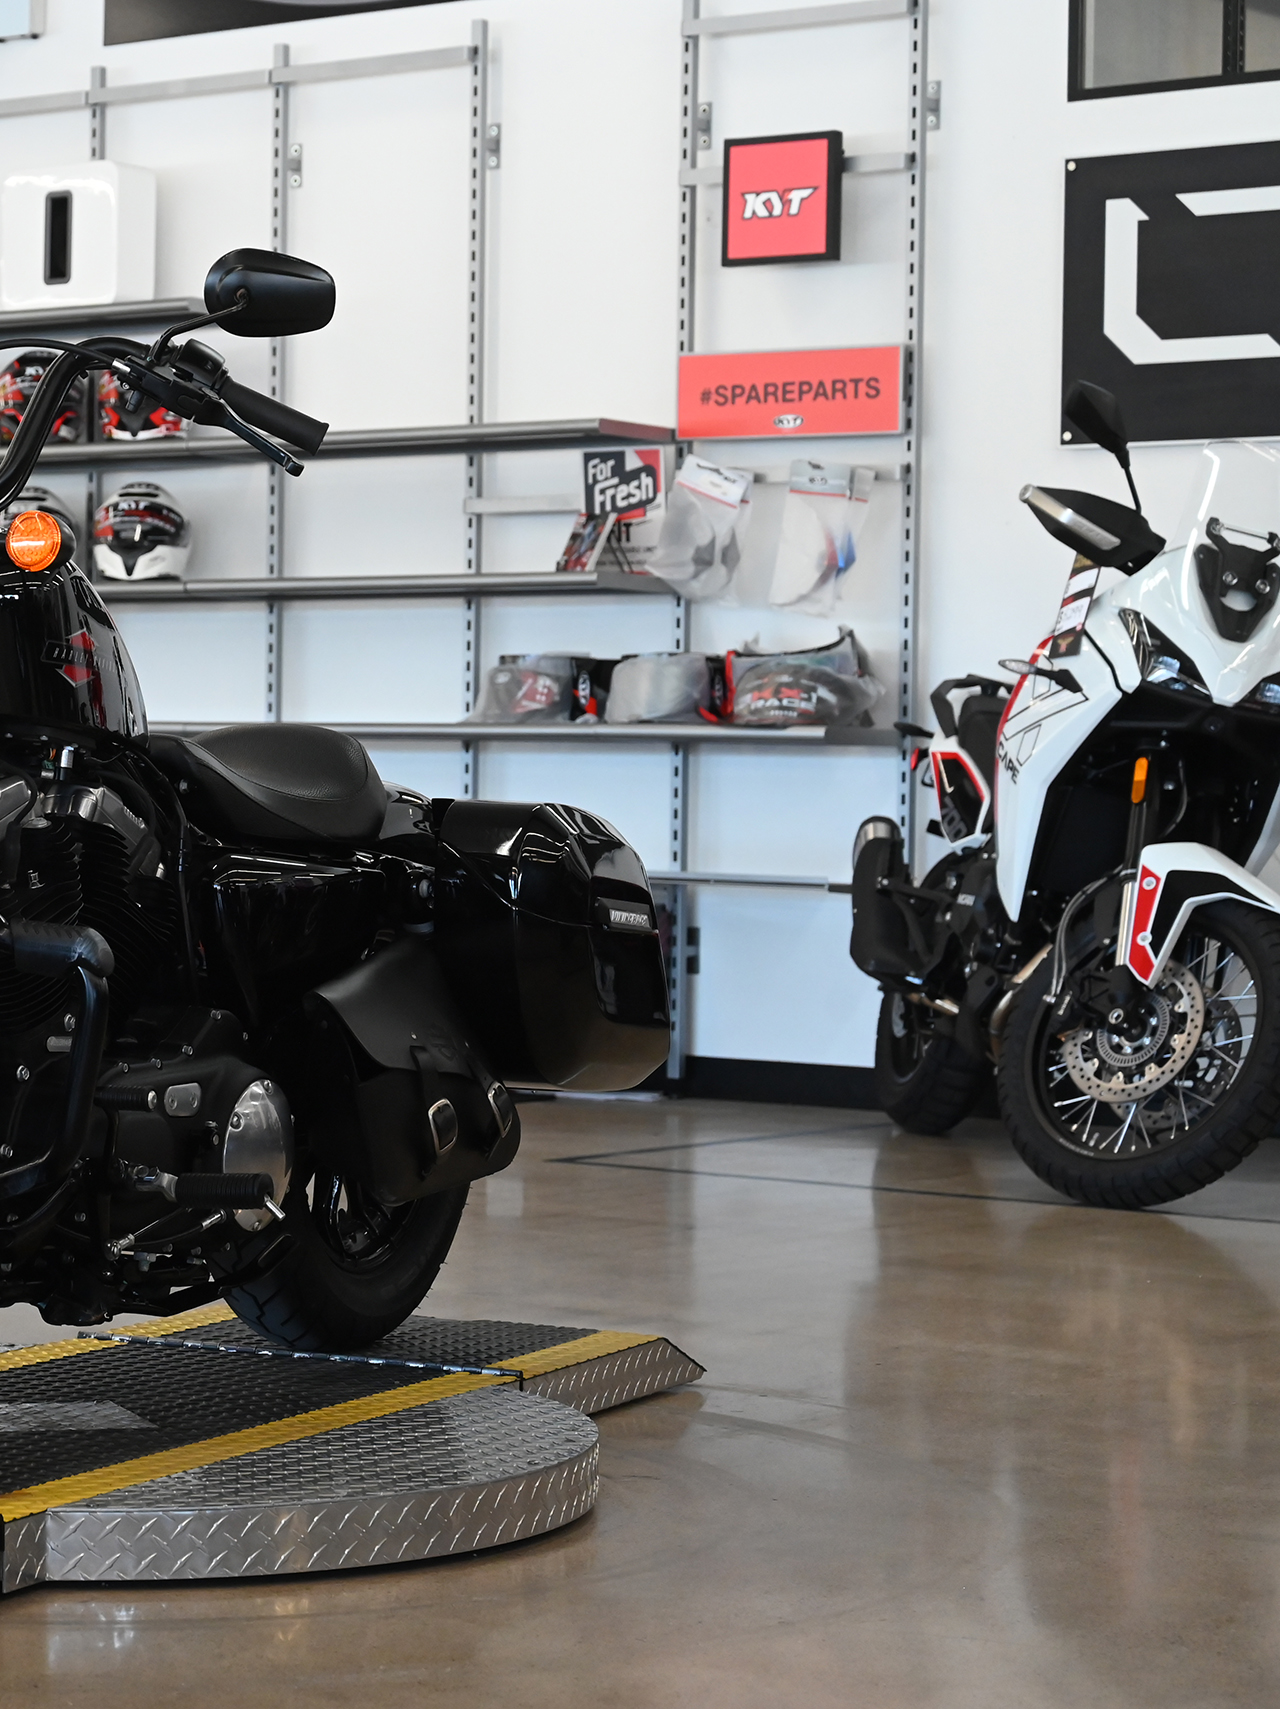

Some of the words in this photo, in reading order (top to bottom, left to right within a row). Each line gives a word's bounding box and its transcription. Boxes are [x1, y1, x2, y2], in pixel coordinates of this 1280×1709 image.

[741, 186, 818, 220] KYT
[699, 376, 881, 407] #SPAREPARTS
[587, 457, 615, 485] For
[593, 472, 654, 515] Fresh
